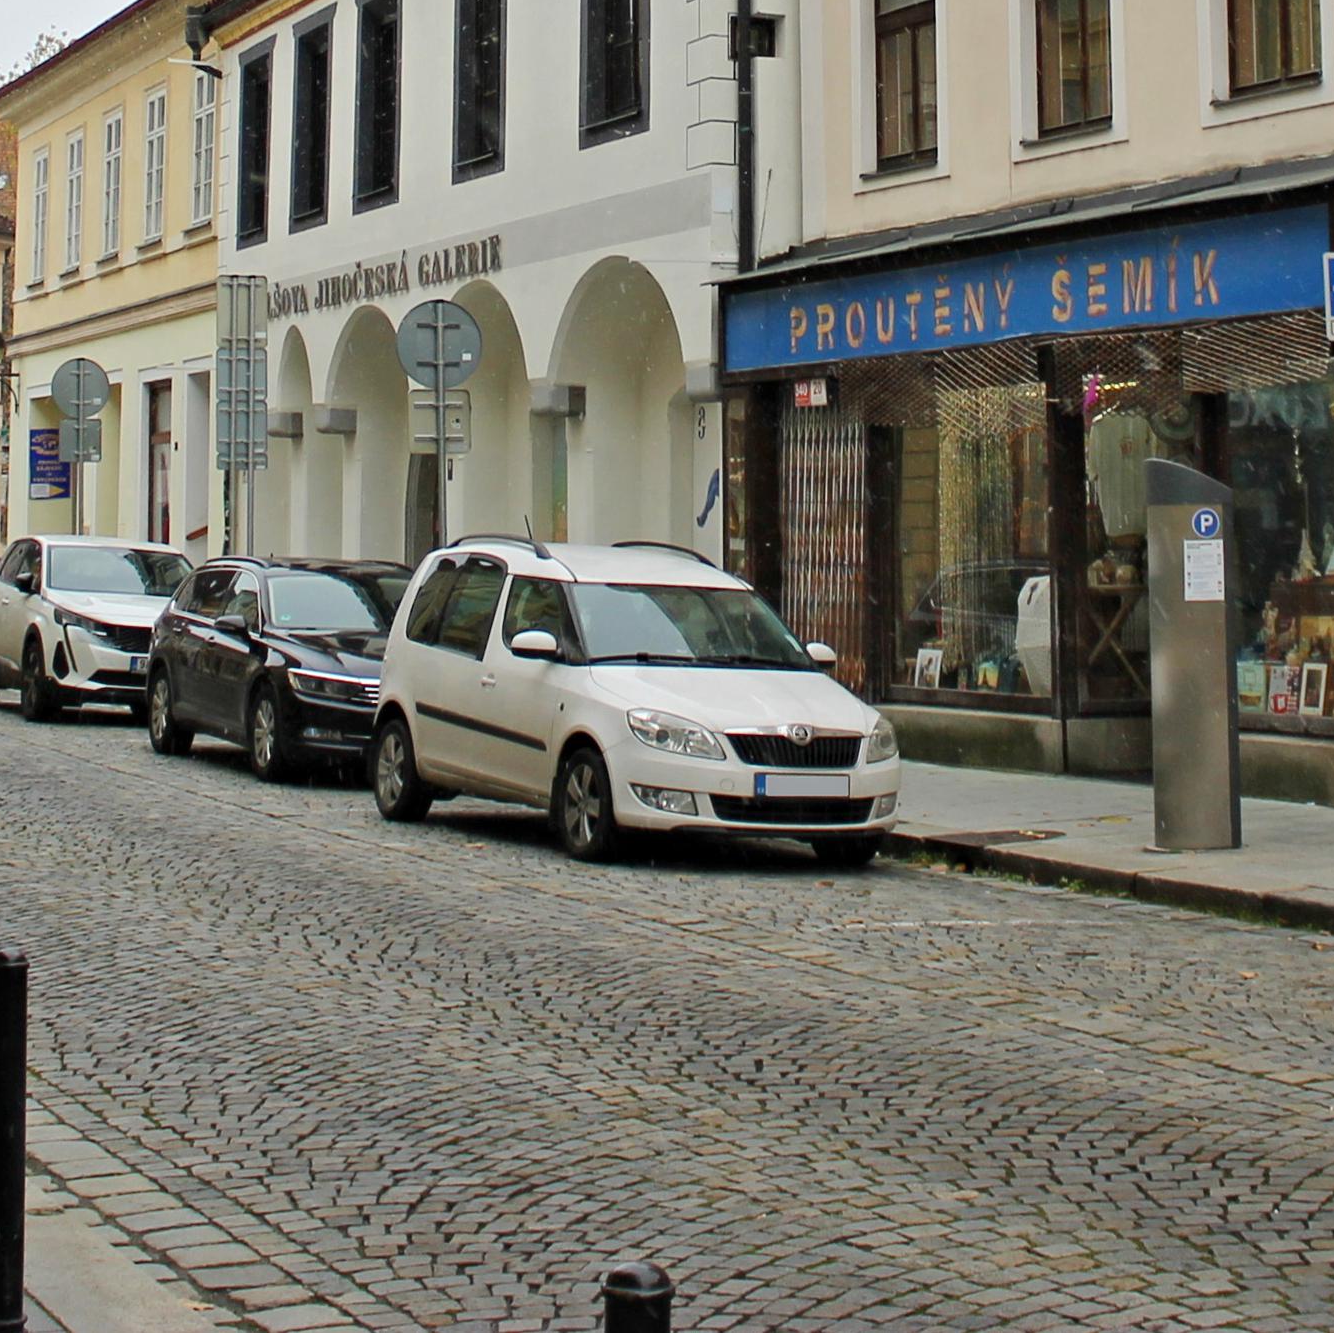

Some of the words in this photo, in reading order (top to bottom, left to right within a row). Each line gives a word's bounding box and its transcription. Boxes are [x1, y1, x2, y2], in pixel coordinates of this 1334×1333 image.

[267, 281, 310, 320] LŠOVA
[314, 248, 410, 310] JIHOČESKÁ
[418, 233, 502, 288] GALERIE
[789, 262, 1014, 354] PROUTĚNÝ
[1051, 234, 1221, 323] ŠEMÍK
